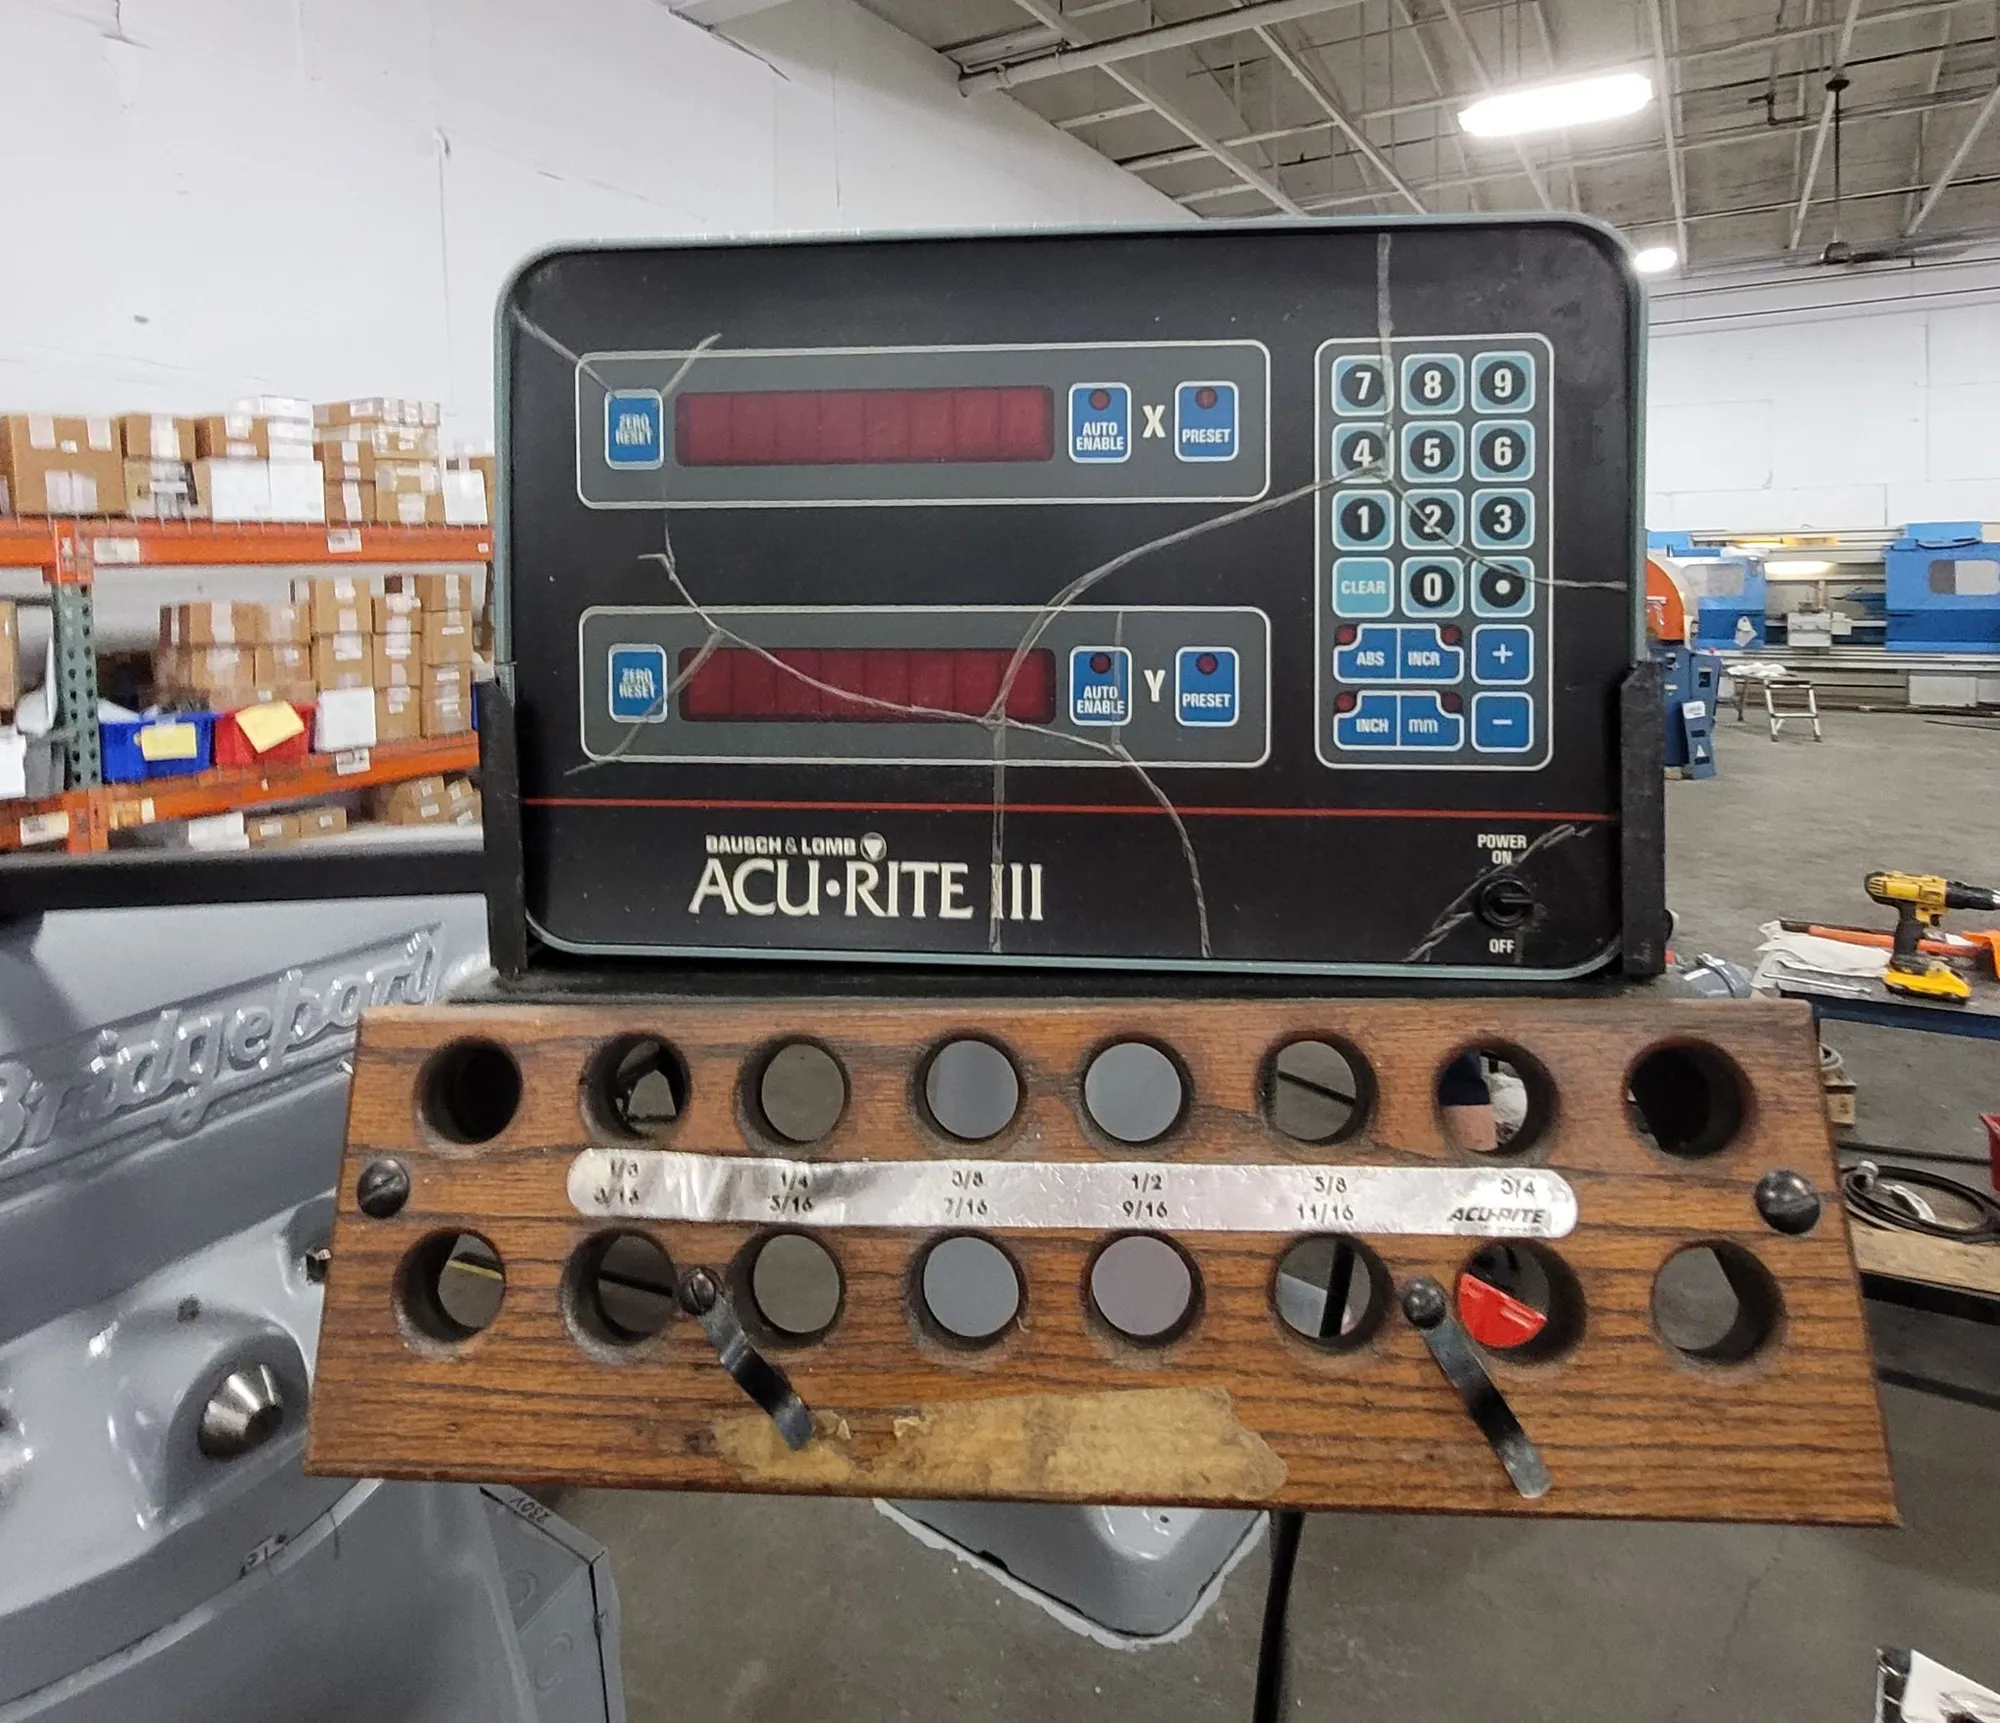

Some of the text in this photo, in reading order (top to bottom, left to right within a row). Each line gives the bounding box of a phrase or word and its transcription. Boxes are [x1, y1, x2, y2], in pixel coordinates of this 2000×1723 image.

[1354, 371, 1372, 400] 7
[1423, 369, 1442, 399] 8
[1493, 368, 1513, 398] 9
[1082, 421, 1118, 436] AUTO
[1141, 404, 1166, 438] X
[1075, 436, 1125, 451] ENABLE
[1181, 428, 1232, 444] PRESET
[1352, 438, 1374, 467] 4
[1423, 437, 1441, 467] 5
[1493, 436, 1512, 466] 6
[1356, 505, 1370, 534] 1
[1422, 504, 1442, 534] 2
[1493, 504, 1512, 534] 3
[1340, 580, 1387, 595] CLEAR
[1423, 572, 1442, 602] 0
[1356, 651, 1385, 666] ABS
[1407, 651, 1441, 667] INCR
[621, 667, 653, 682] ZERO
[618, 682, 655, 700] RESET
[1083, 685, 1118, 699] AUTO
[1142, 669, 1166, 703] Y
[1076, 699, 1125, 715] ENABLE
[1182, 692, 1232, 708] PRESET
[1356, 718, 1389, 733] INCH
[1408, 719, 1438, 733] mm
[784, 836, 798, 855] &
[800, 836, 857, 856] LOMB
[1477, 833, 1528, 849] POWER
[1491, 850, 1513, 864] ON
[990, 862, 1044, 921] III
[1488, 939, 1516, 954] OFF
[1131, 1172, 1163, 1193] 1/2
[1313, 1175, 1348, 1196] 5/8
[768, 1194, 814, 1215] 5/16
[943, 1196, 989, 1218] 7/16
[1122, 1199, 1168, 1220] 9/16
[1296, 1202, 1355, 1224] 11/16
